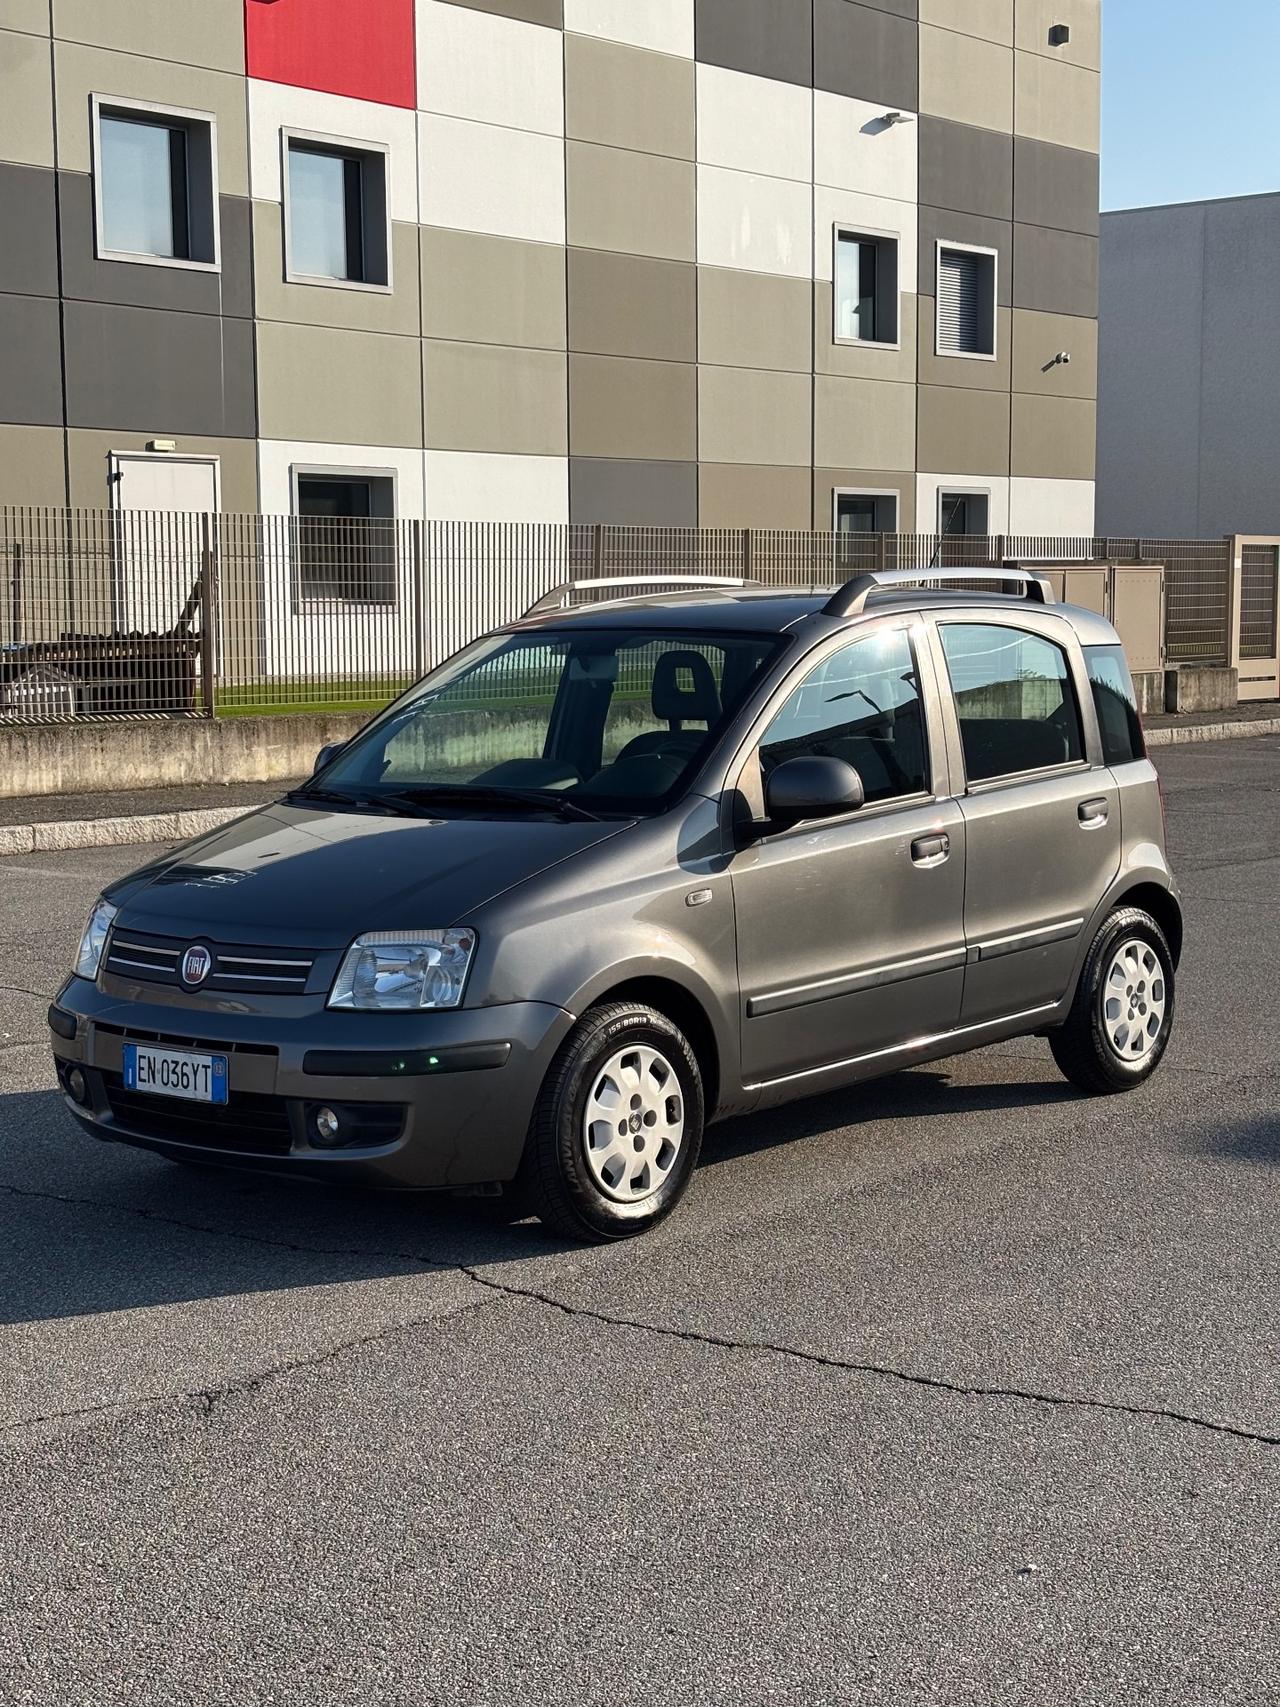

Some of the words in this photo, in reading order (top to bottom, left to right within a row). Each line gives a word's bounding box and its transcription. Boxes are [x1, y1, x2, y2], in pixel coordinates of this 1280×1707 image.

[187, 956, 205, 975] FIAT
[138, 1055, 156, 1084] EN
[161, 1059, 210, 1092] 036YT
